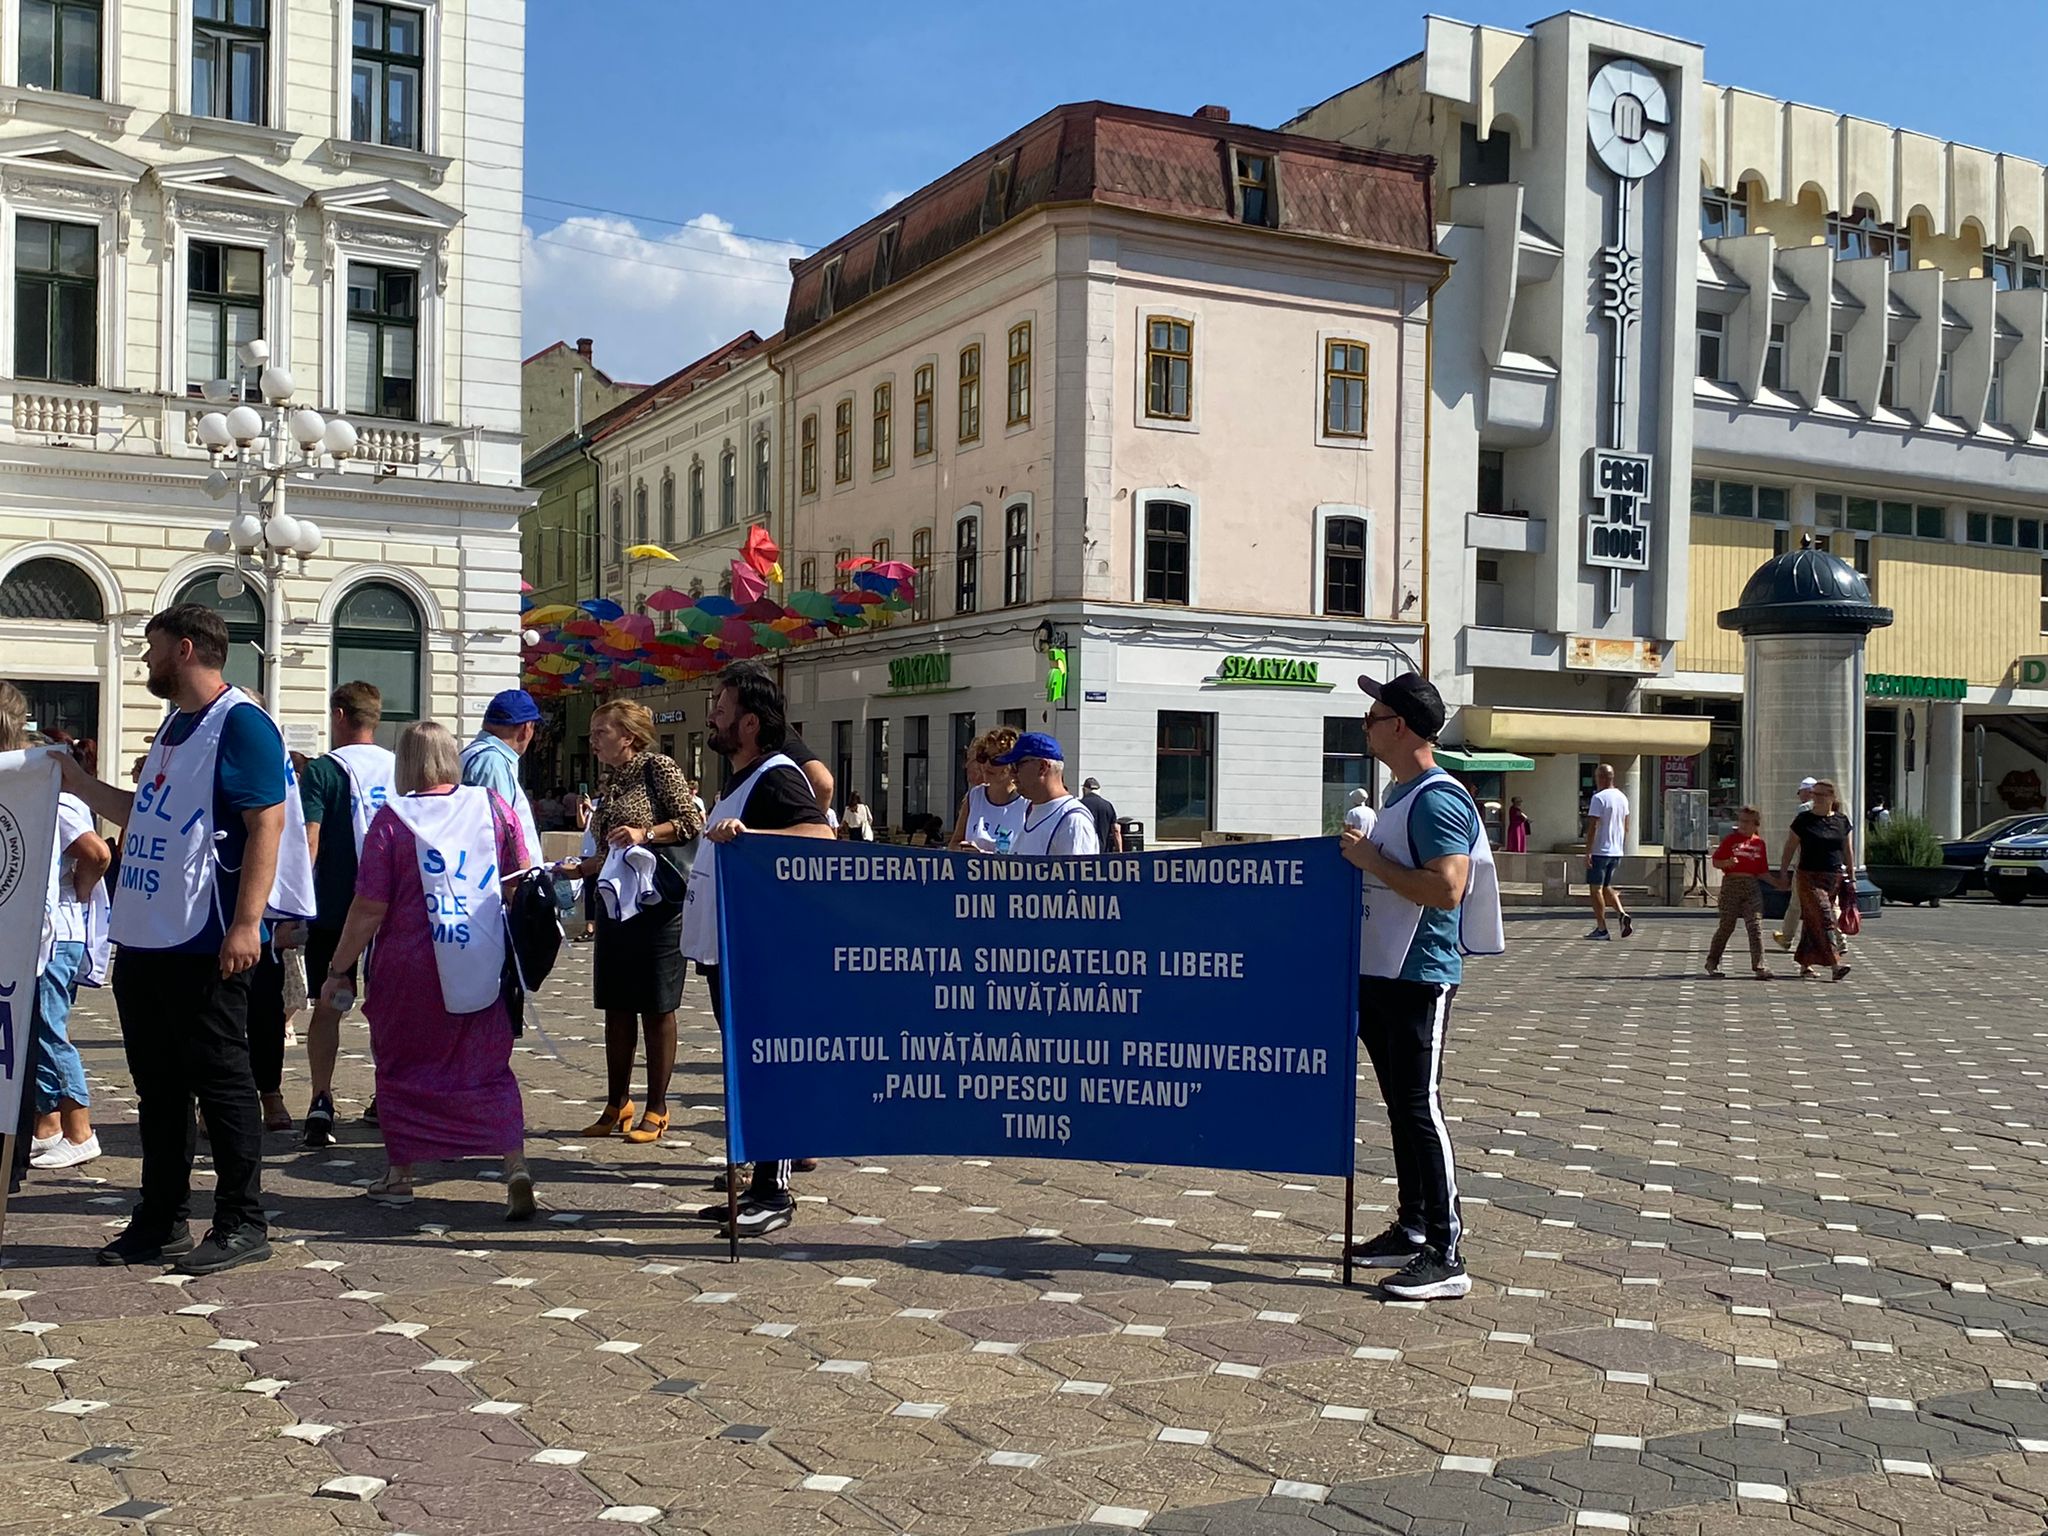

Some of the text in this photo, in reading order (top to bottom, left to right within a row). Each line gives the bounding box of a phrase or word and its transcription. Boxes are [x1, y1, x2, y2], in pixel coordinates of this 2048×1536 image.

[1600, 459, 1644, 493] CASA
[1610, 494, 1633, 525] DE
[1593, 526, 1642, 561] MODE
[888, 652, 952, 687] SPARTAN
[1223, 655, 1319, 683] SPARTAN
[1865, 674, 1967, 698] ICHMANN
[1665, 762, 1689, 771] DEAL
[125, 833, 168, 862] OLE
[121, 864, 160, 901] IMIȘ
[775, 856, 1304, 885] CONFEDERAȚIA SINDICATELOR DEMOCRATE
[955, 889, 1121, 920] DIN ROMÂNIA
[834, 947, 1244, 978] FEDERAȚIA SINDICATELOR LIBERE
[935, 980, 1142, 1015] DIN ÎNVĂȚĂMÂNT
[752, 1030, 1327, 1075] SINDICATUL ÎNVĂȚĂMÂNTULUI PREUNIVERSITAR
[958, 1074, 1067, 1102] POPESCU
[1002, 1113, 1071, 1145] TIMIȘ
